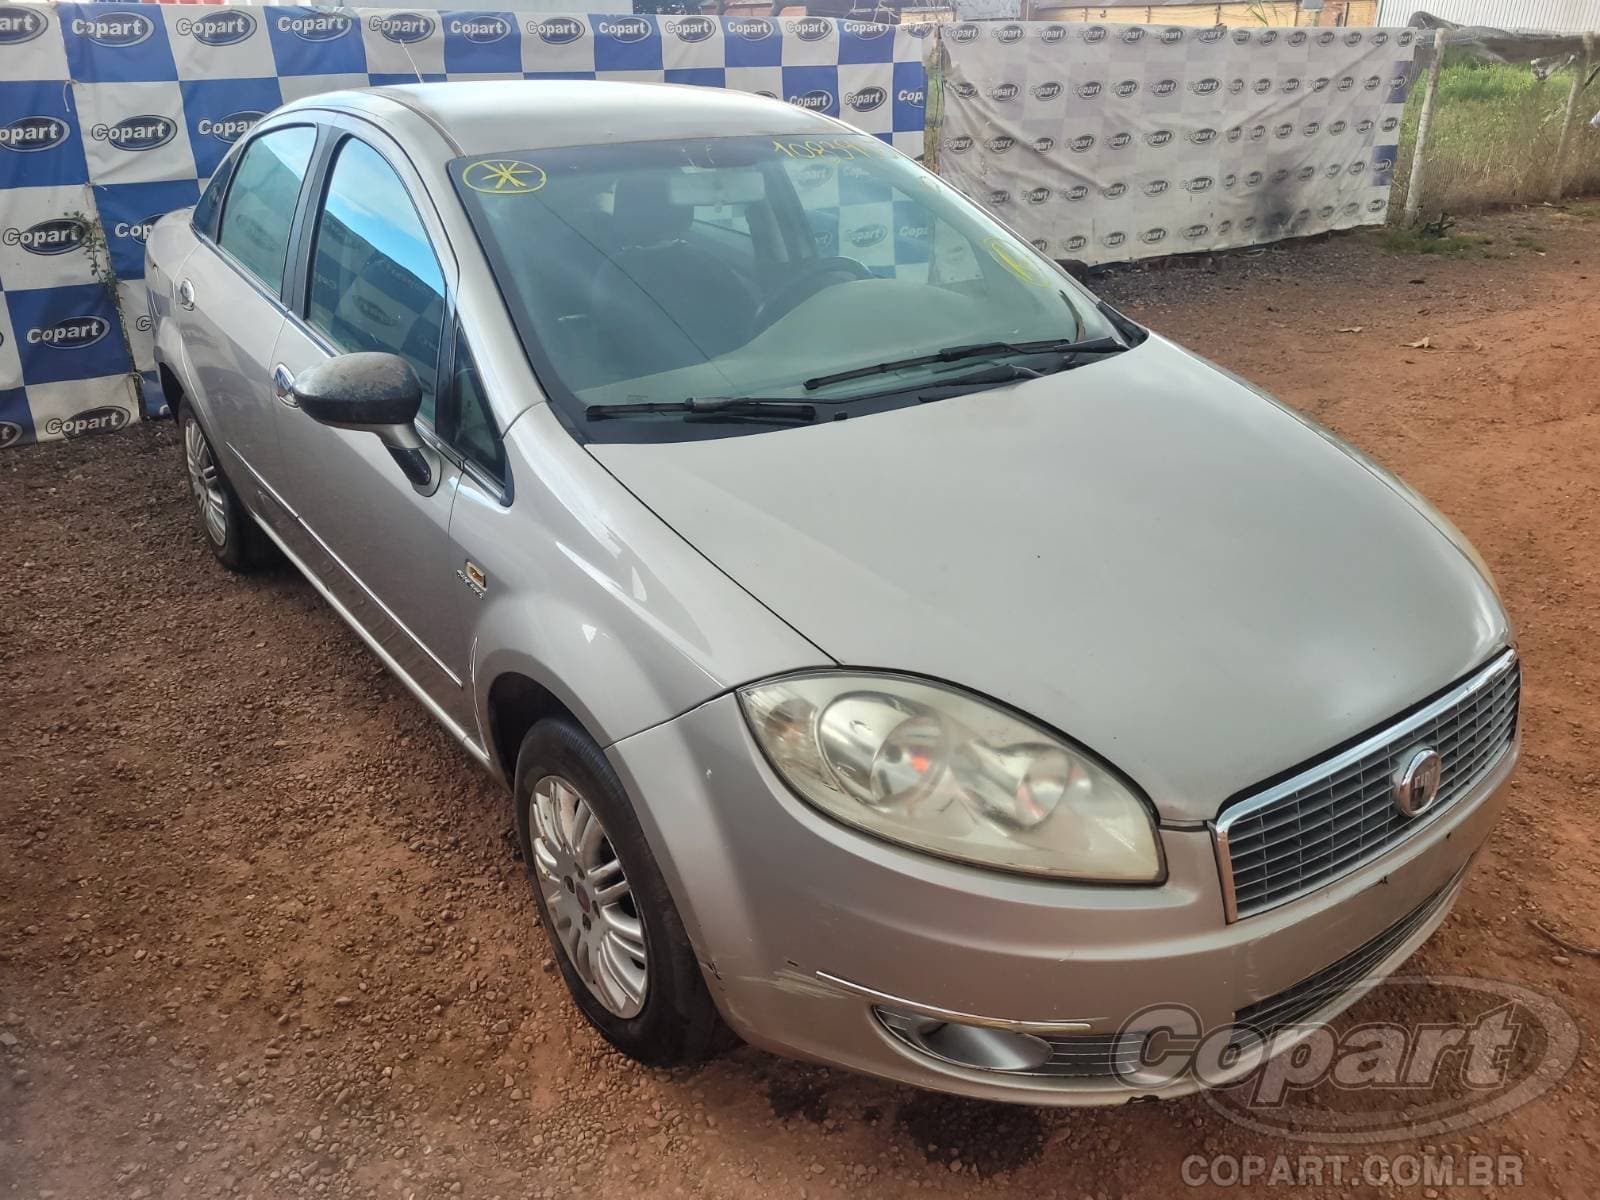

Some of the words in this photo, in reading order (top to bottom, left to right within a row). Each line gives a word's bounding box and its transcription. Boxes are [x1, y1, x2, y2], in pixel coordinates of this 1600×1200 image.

[0, 13, 33, 31] art
[71, 18, 142, 39] Copart
[176, 17, 245, 38] Copart
[277, 15, 344, 35] Copart
[368, 15, 425, 34] Copart
[451, 20, 503, 36] Copart
[526, 20, 577, 37] Copart
[600, 21, 646, 36] Copart
[665, 20, 709, 36] Copart
[728, 21, 768, 34] Copart
[786, 21, 825, 34] Copart
[843, 22, 884, 34] Copart
[944, 27, 977, 40] Copart
[789, 95, 827, 109] Copart
[845, 91, 881, 106] Copart
[898, 90, 924, 102] Cop
[0, 120, 59, 144] opart
[92, 121, 165, 142] Copart
[3, 225, 79, 246] Copart
[115, 222, 151, 240] Cop
[26, 321, 99, 344] Copart
[46, 411, 119, 434] Copart
